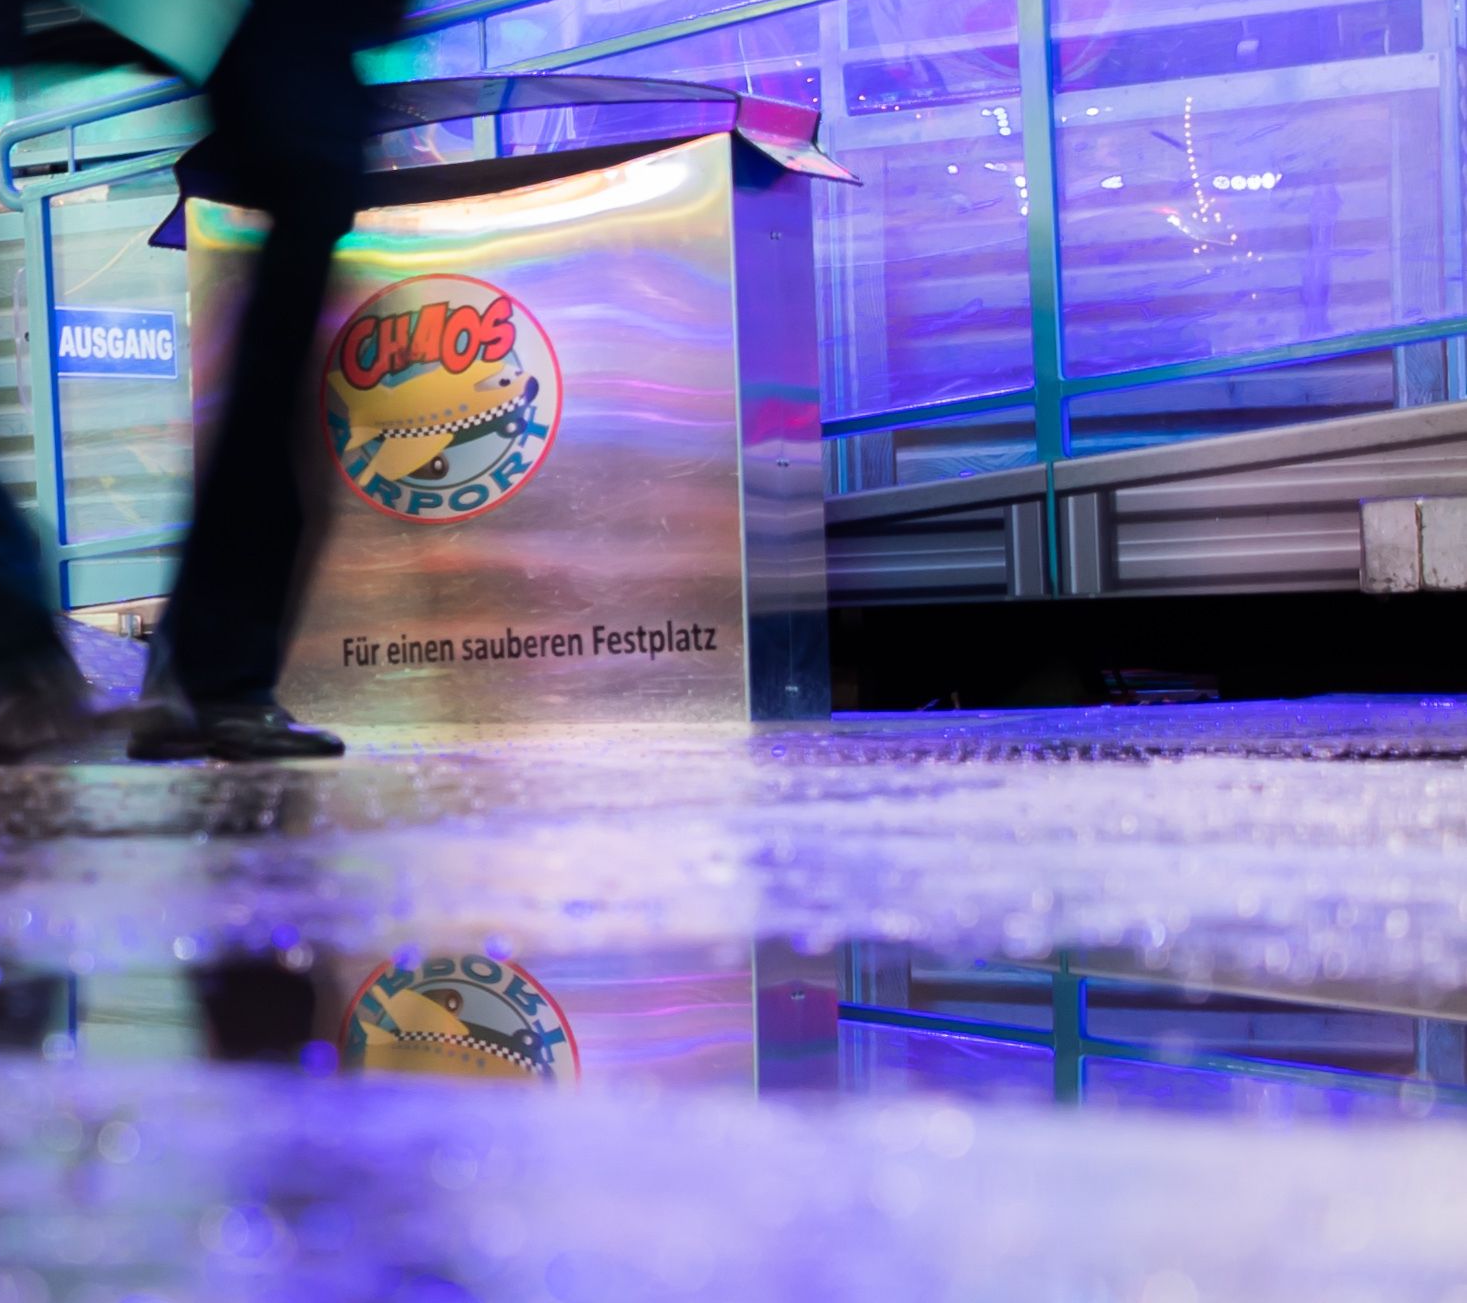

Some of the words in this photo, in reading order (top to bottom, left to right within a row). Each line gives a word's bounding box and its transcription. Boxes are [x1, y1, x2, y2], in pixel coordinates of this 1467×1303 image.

[58, 325, 174, 361] AUSGANG
[340, 296, 516, 390] CHAOS
[327, 406, 549, 515] AIRPORT
[343, 636, 380, 669] Für
[388, 632, 456, 665] einen
[462, 626, 584, 661] sauberen
[593, 622, 717, 664] Festplatz
